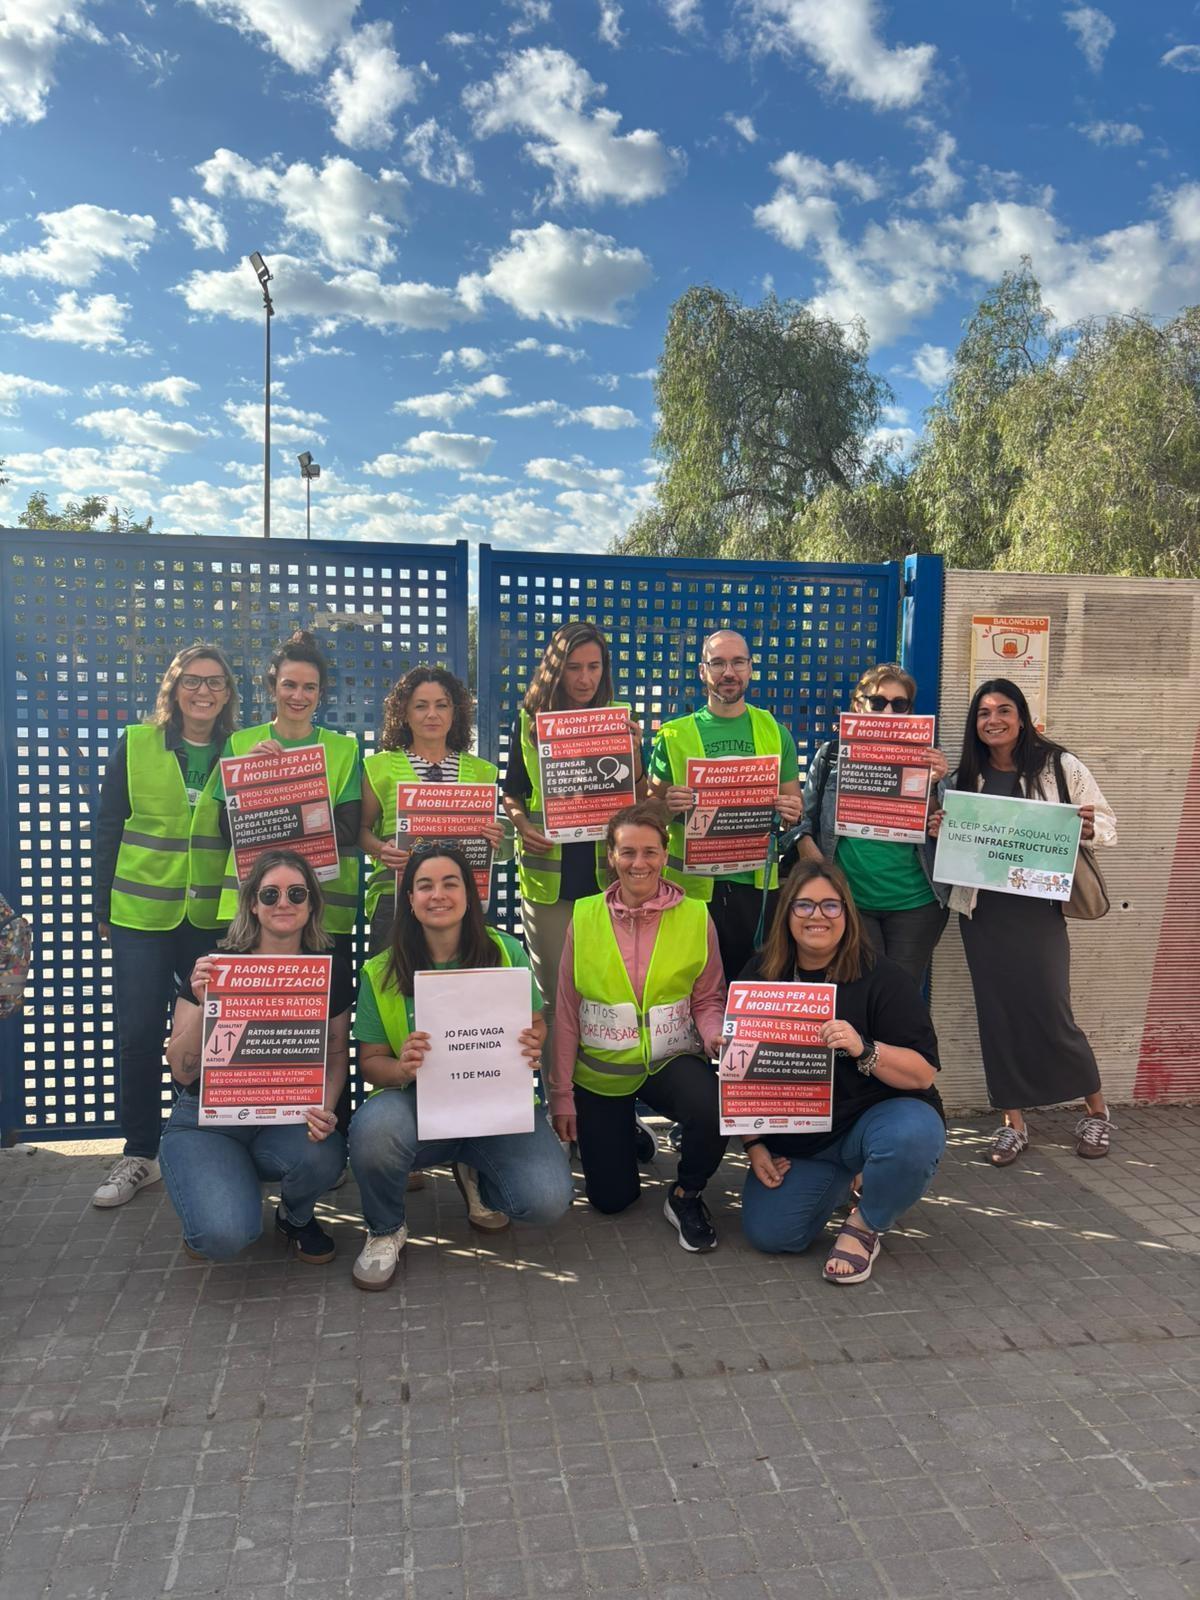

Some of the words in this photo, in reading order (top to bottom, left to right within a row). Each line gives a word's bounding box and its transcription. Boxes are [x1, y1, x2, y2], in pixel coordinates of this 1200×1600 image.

[994, 618, 1045, 626] BALONCESTO
[542, 719, 555, 736] 7
[845, 719, 858, 735] 7
[859, 720, 891, 728] RAONS
[857, 730, 930, 740] MOBILITZACIÓ
[543, 746, 550, 755] 6
[841, 747, 848, 756] 4
[244, 759, 279, 770] RAONS
[281, 756, 299, 765] PER
[310, 752, 321, 760] LA
[546, 761, 585, 769] DEFENSAR
[226, 764, 241, 783] 7
[244, 762, 322, 782] MOBILITZACIÓ
[557, 767, 592, 776] VALENCIÀ
[693, 767, 706, 783] 7
[559, 776, 597, 784] DEFENSAR
[706, 771, 776, 783] MOBILITZACIÓ
[548, 785, 582, 793] L'ESCOLA
[584, 782, 614, 790] PÚBLICA
[841, 784, 890, 792] PROFESSORAT
[241, 791, 263, 799] PROU
[403, 789, 417, 806] 7
[229, 798, 238, 808] 4
[243, 797, 278, 808] L'ESCOLA
[417, 799, 492, 808] MOBILITZACIÓ
[245, 808, 290, 820] PAPERASSA
[235, 821, 261, 830] OFEGA
[262, 814, 297, 825] L'ESCOLA
[400, 820, 408, 831] 5
[236, 826, 268, 837] PÚBLICA
[284, 822, 298, 830] SEU
[949, 820, 958, 828] EL
[961, 822, 980, 830] CEIP
[982, 825, 1006, 834] SANT
[1008, 827, 1051, 841] PASQUAL
[1054, 834, 1071, 843] VOL
[237, 831, 291, 845] PROFESSORAT
[948, 833, 971, 842] UNES
[974, 836, 1068, 855] INFRAESTRUCTURES
[988, 851, 1024, 862] DIGNES
[234, 966, 275, 974] RAONS
[216, 965, 231, 986] 7
[231, 976, 325, 987] MOBILITZACIÓ
[733, 990, 748, 1009] 7
[750, 991, 784, 999] RAONS
[786, 992, 805, 1000] PER
[817, 993, 830, 1001] LA
[266, 998, 284, 1006] LES
[208, 1003, 218, 1015] 3
[281, 1009, 320, 1017] MILLOR!
[746, 1002, 830, 1014] MOBILITZACIÓ
[726, 1023, 734, 1033] 3
[741, 1020, 773, 1028] BAIXAR
[458, 1029, 478, 1037] FAIG
[480, 1027, 504, 1035] VAGA
[739, 1030, 787, 1040] ENSENYAR
[449, 1041, 501, 1051] INDEFINIDA
[759, 1050, 784, 1058] RÀTIOS
[477, 1070, 501, 1078] MAIG
